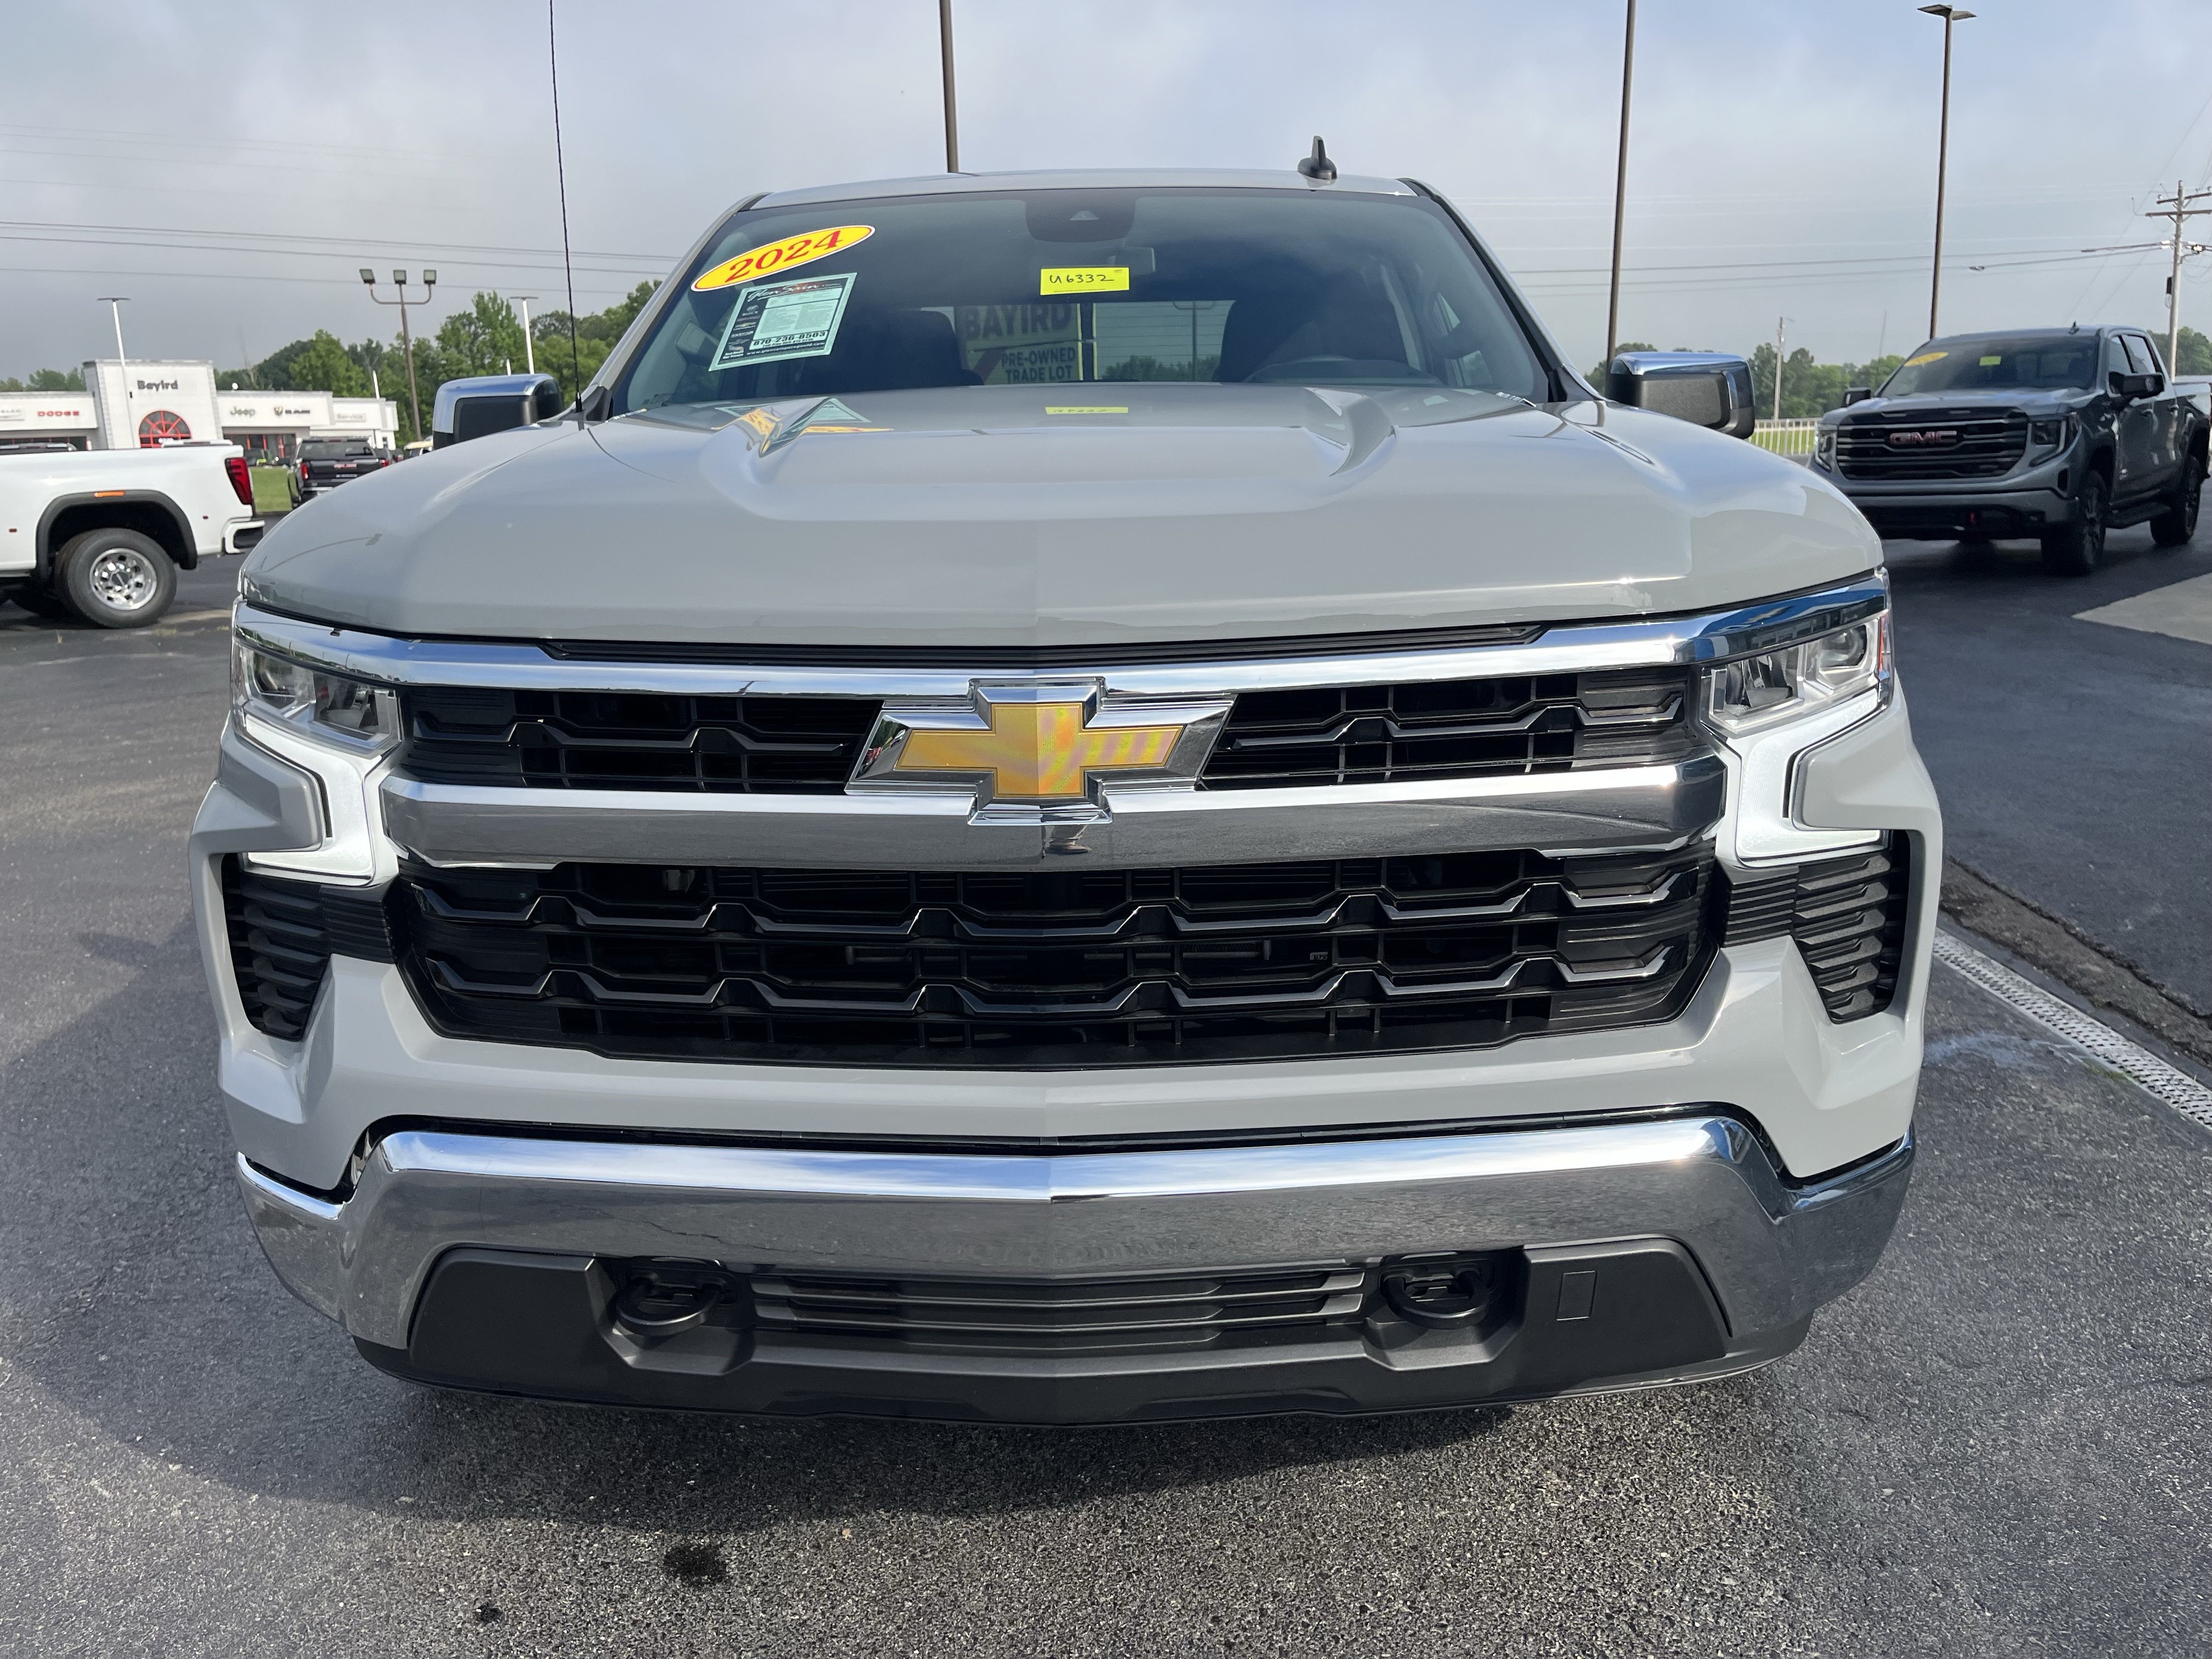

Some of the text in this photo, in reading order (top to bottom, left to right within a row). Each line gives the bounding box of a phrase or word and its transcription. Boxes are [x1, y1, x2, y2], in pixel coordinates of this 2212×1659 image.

[725, 230, 843, 283] 2024
[964, 304, 1072, 339] BAYIRD
[1001, 347, 1076, 367] PRE-OWNED
[1005, 365, 1073, 384] TRADE LOT
[137, 380, 178, 392] Bayird
[230, 406, 256, 417] Jeep
[1889, 430, 1957, 445] GMC
